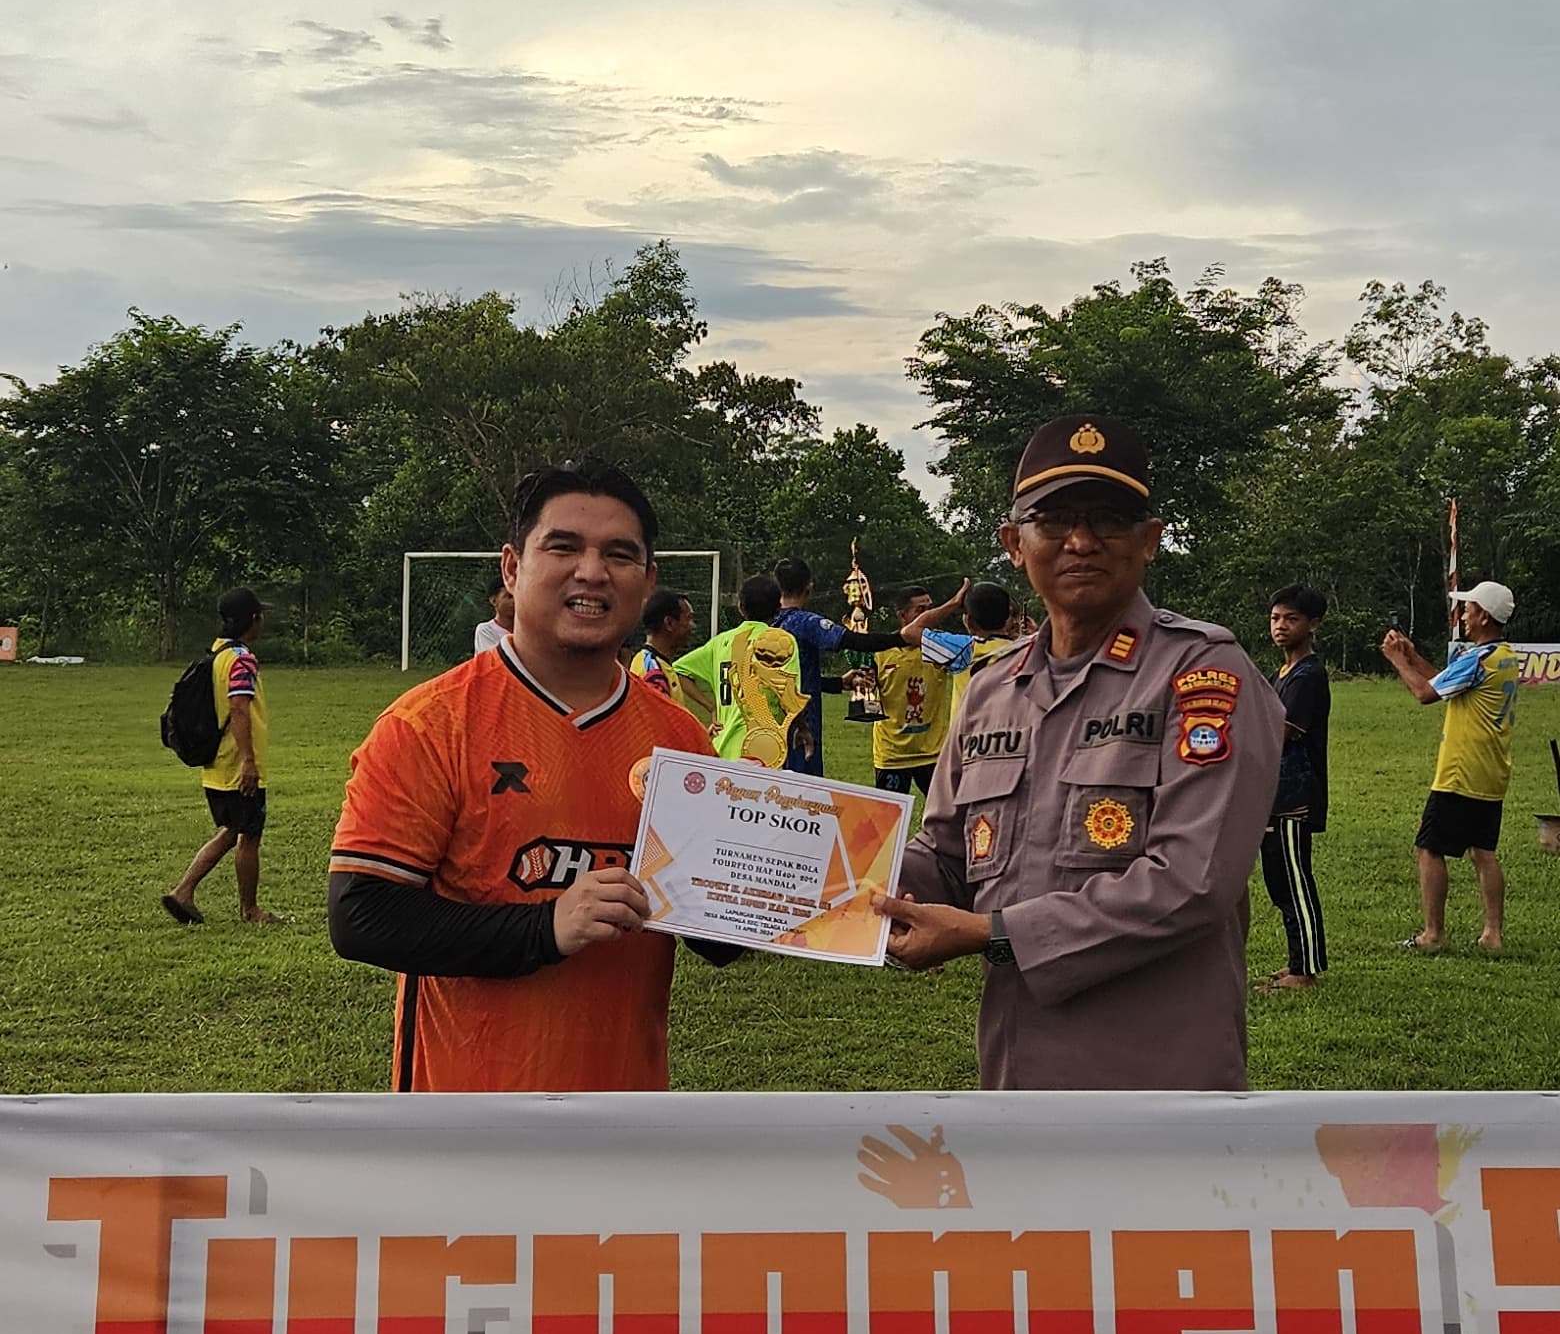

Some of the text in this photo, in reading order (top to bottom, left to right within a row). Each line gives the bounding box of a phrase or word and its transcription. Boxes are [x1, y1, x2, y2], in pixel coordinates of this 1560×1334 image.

[1177, 670, 1238, 688] POLRES
[1085, 712, 1154, 742] POLRI
[968, 730, 1022, 758] PUTU
[727, 804, 821, 836] TOP SKOR
[712, 857, 754, 871] FOURFEO
[715, 847, 819, 874] TURNAMEN SEPAK BOLA
[730, 871, 797, 890] DESA MANDALA
